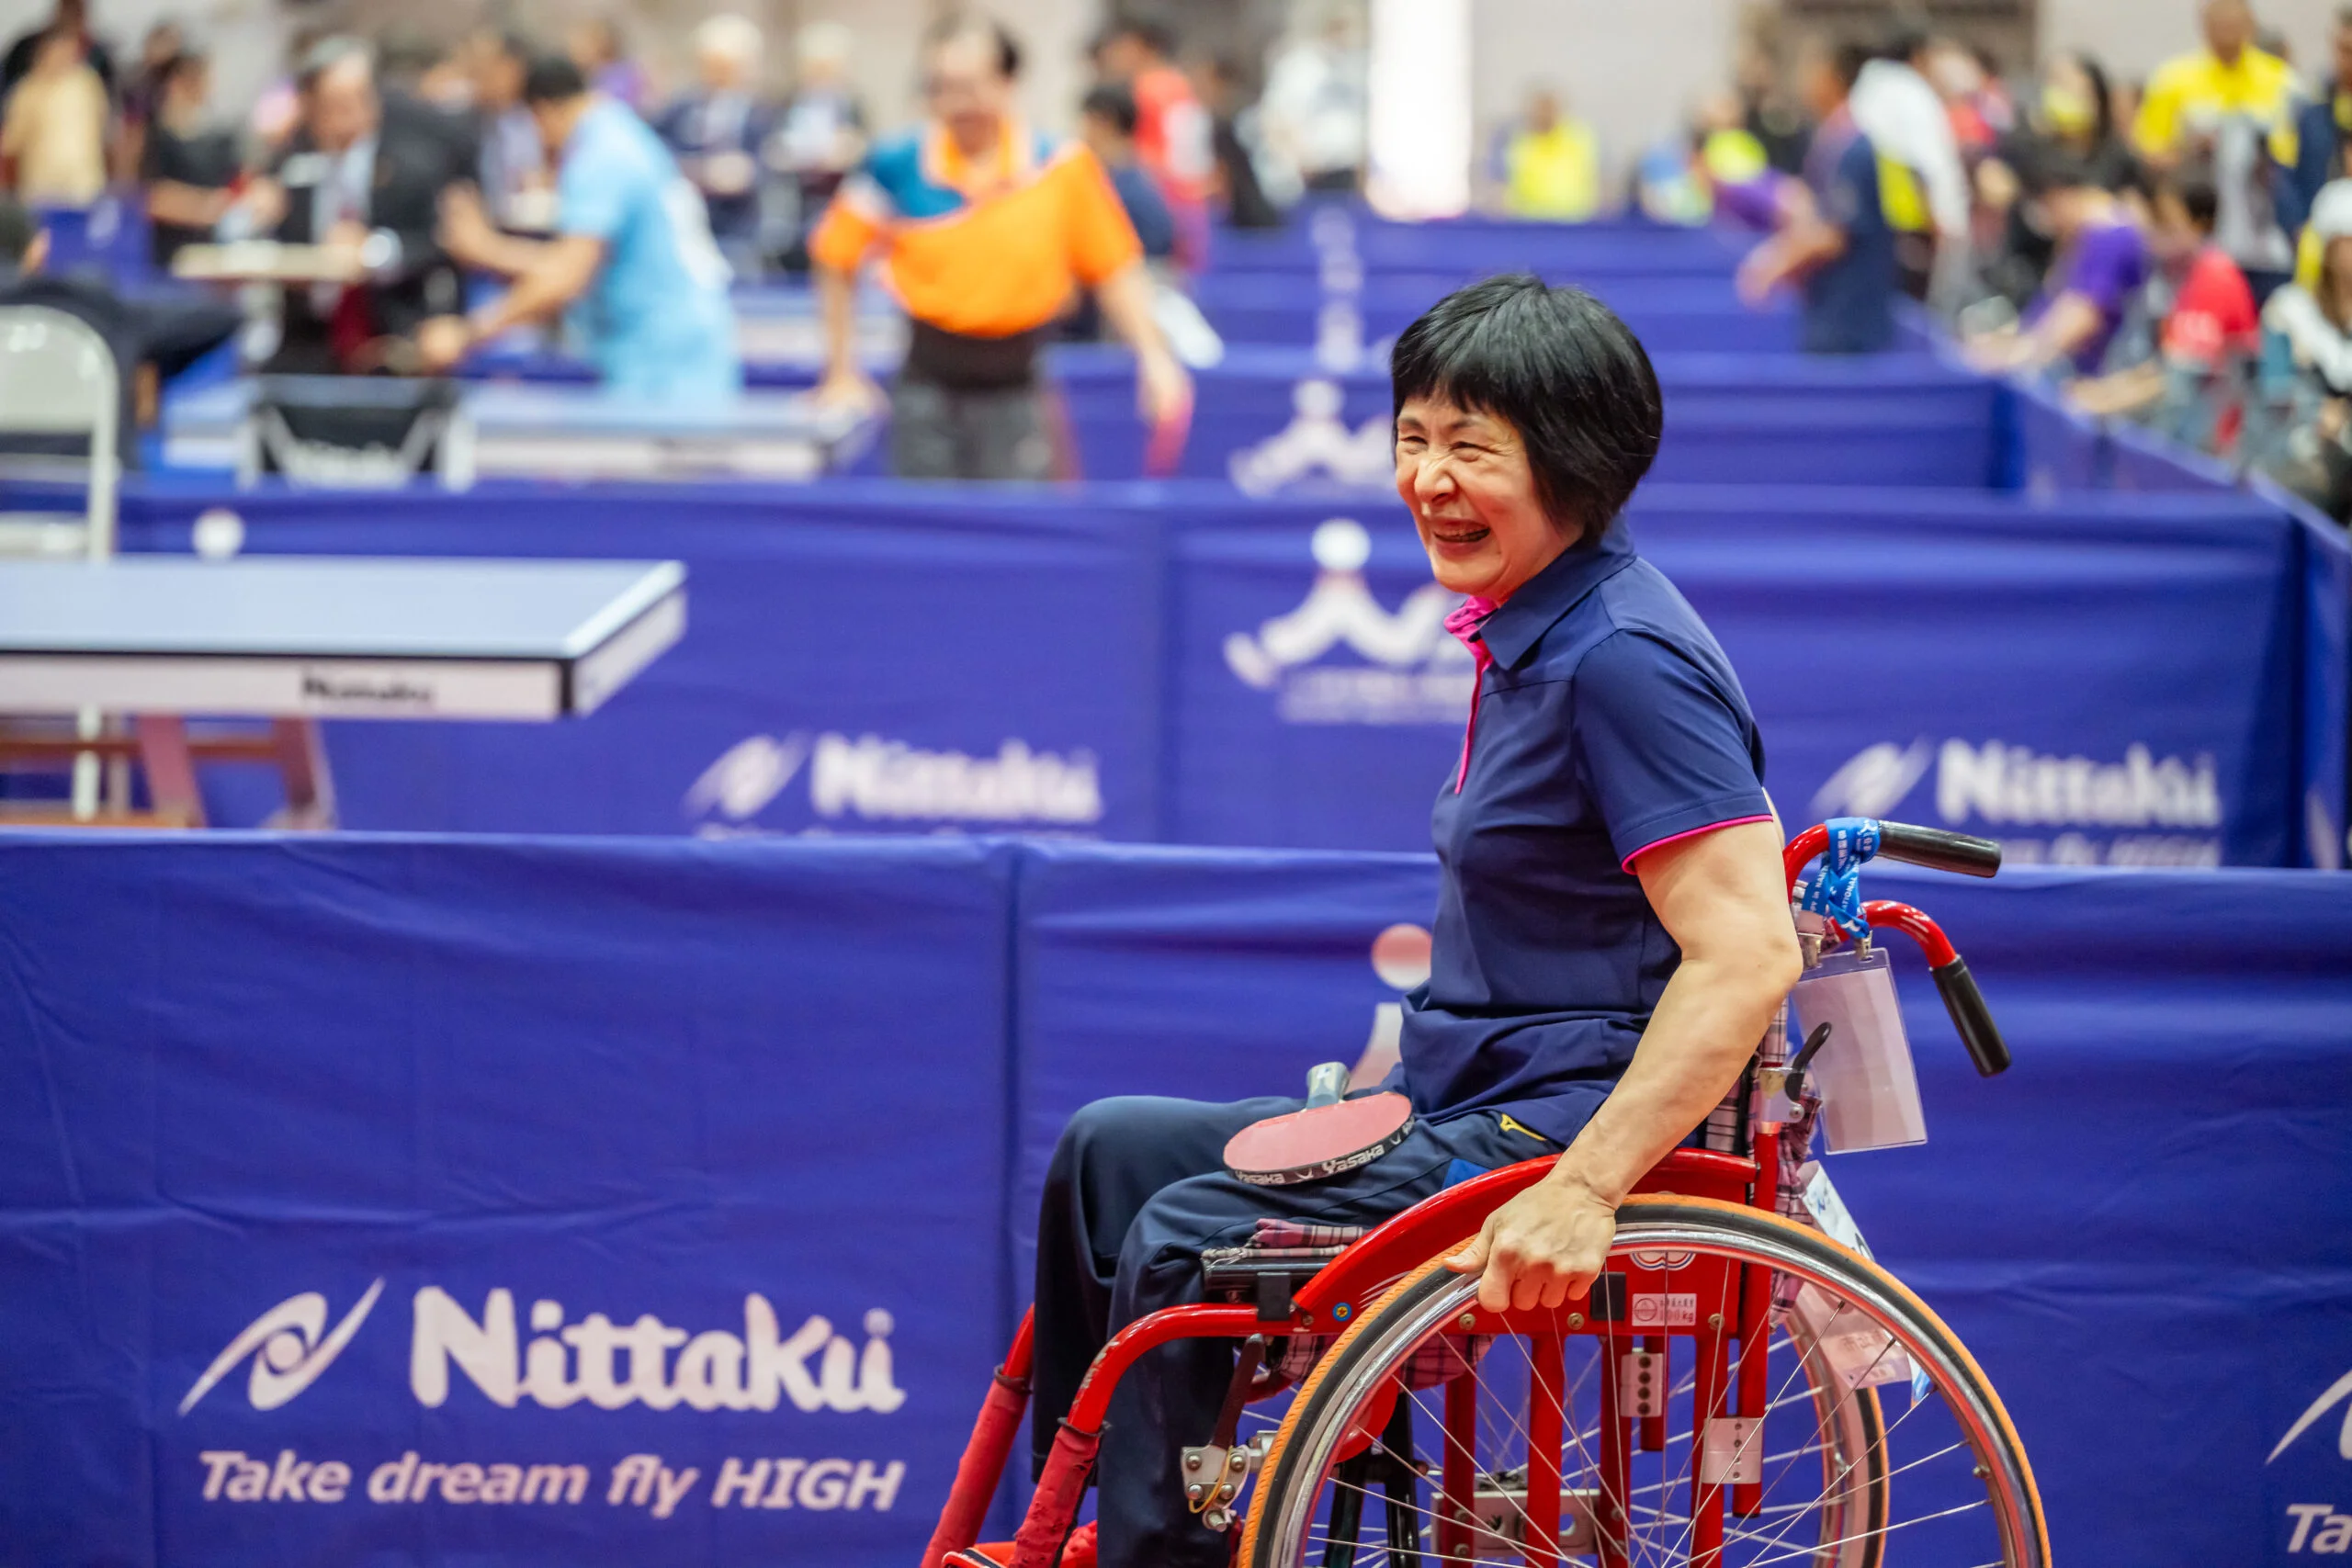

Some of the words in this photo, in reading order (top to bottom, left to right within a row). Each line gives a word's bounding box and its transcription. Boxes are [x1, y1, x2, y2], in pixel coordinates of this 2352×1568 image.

[1322, 1144, 1385, 1175] Yasaka
[410, 1286, 906, 1413] Nittaku
[198, 1450, 352, 1504] Take
[368, 1450, 589, 1505] dream
[605, 1453, 699, 1519] fly
[710, 1458, 907, 1511] HIGH
[2286, 1503, 2352, 1554] Ta
